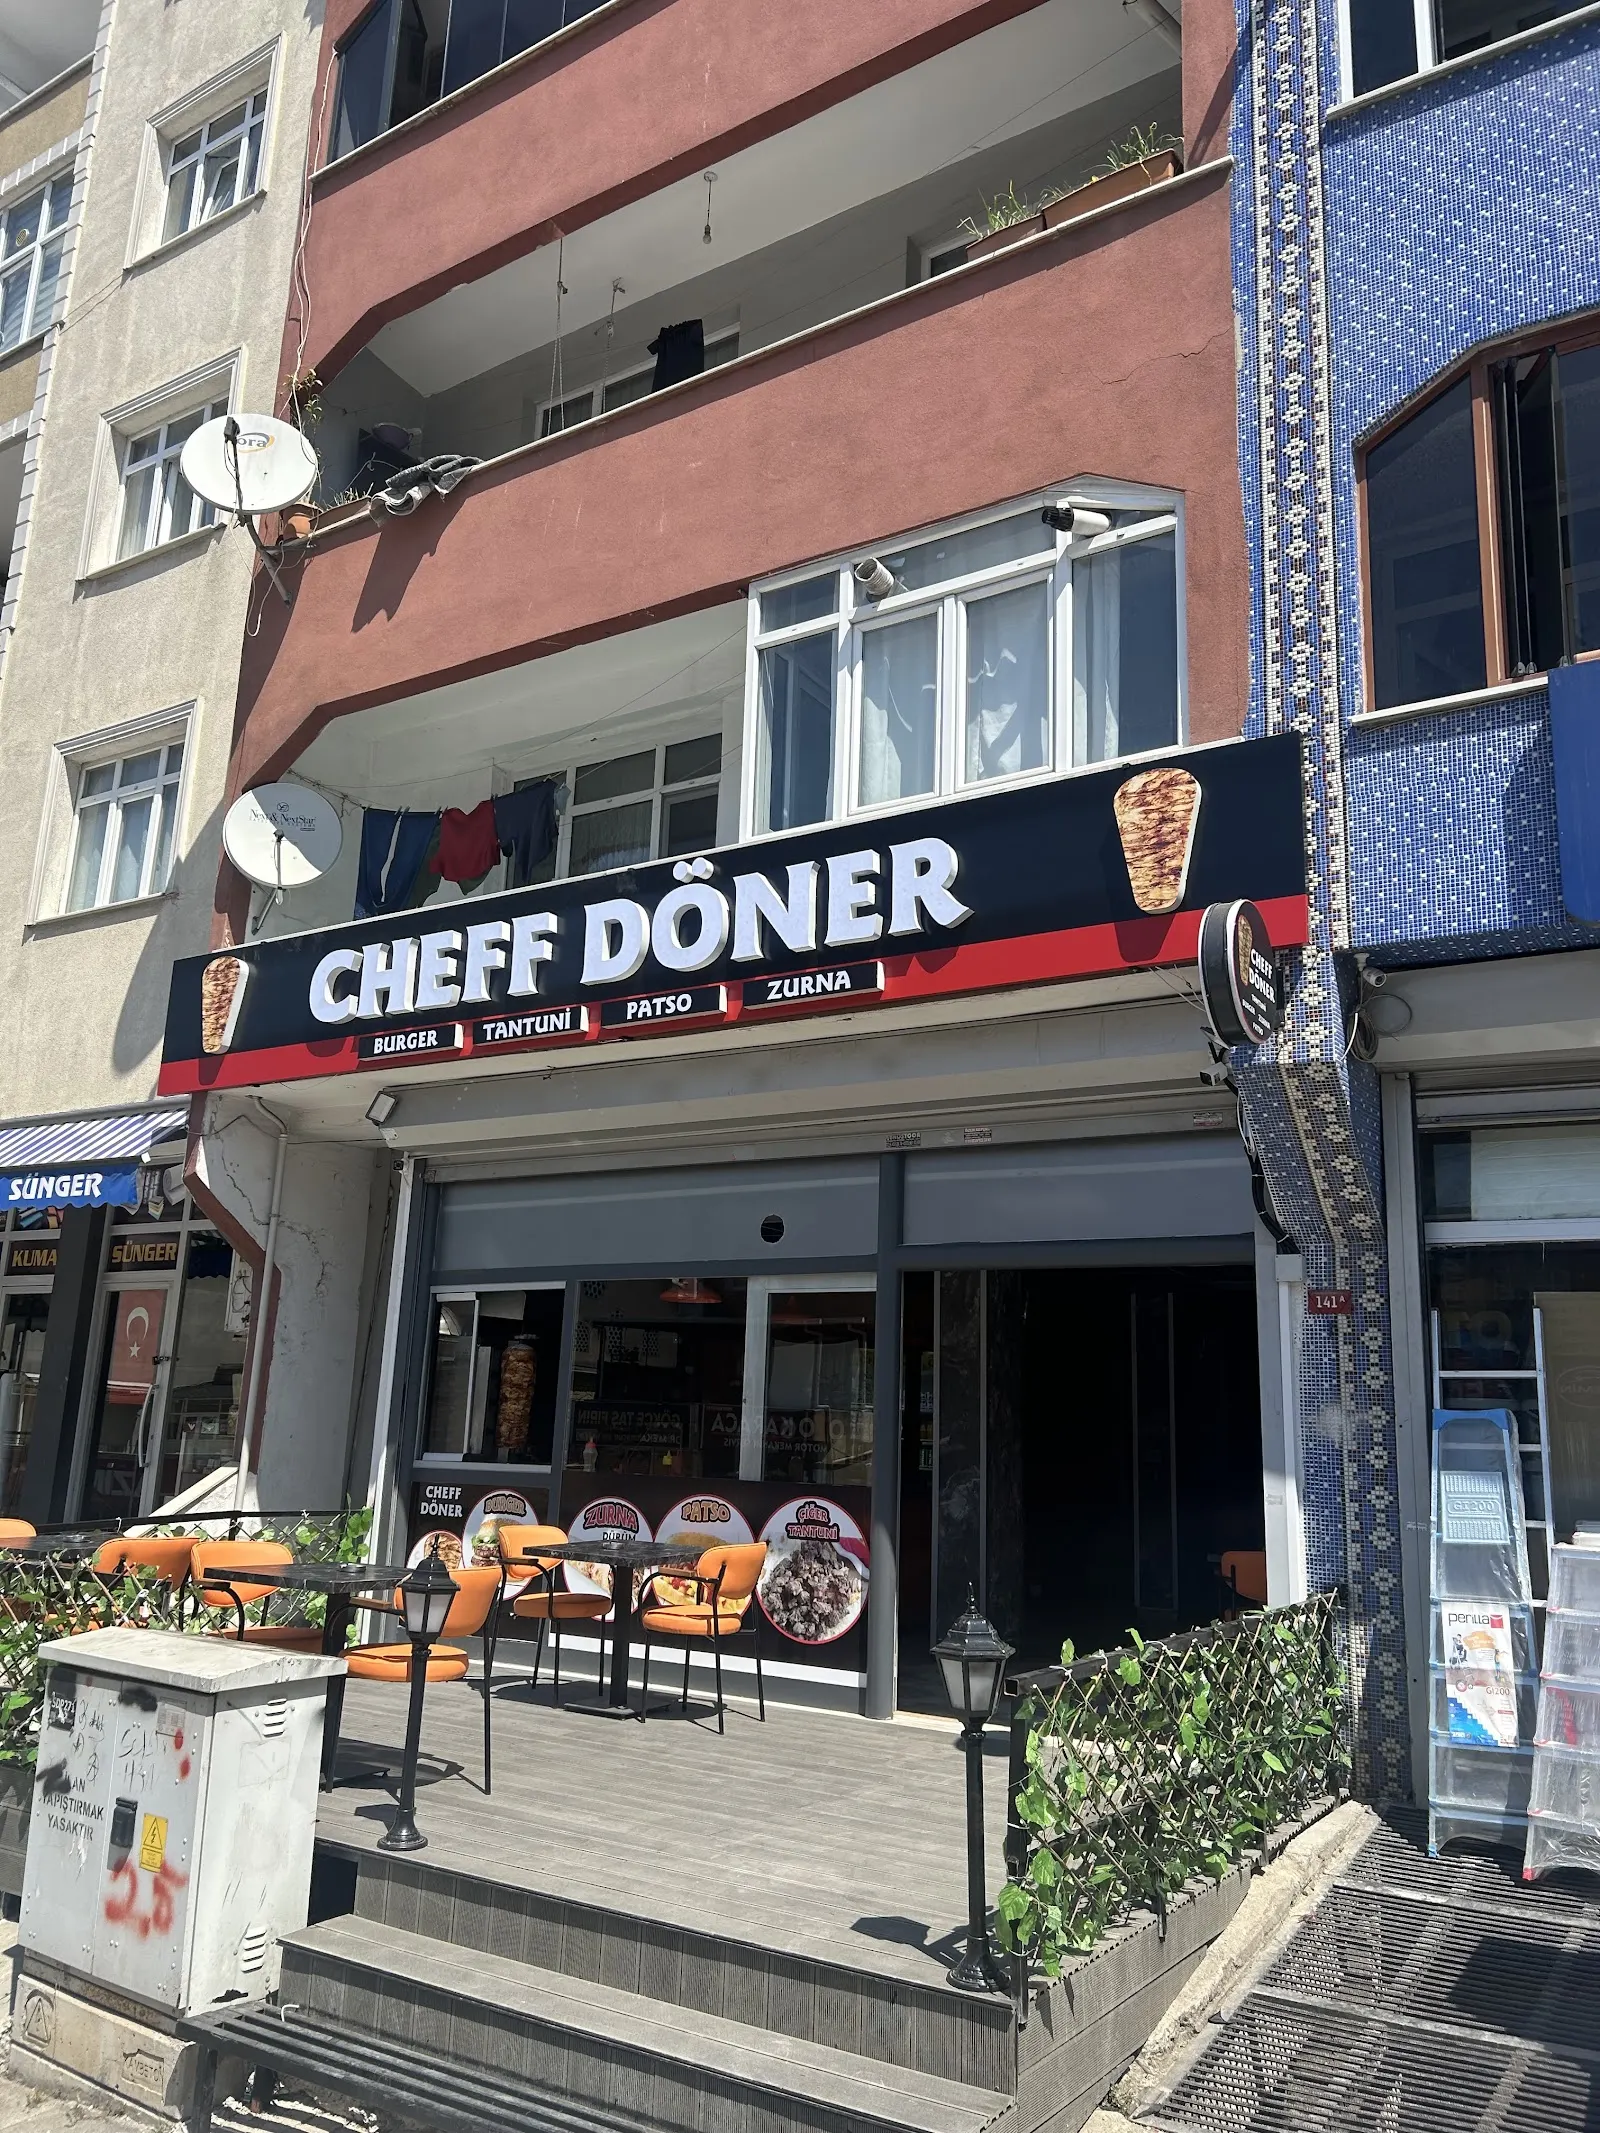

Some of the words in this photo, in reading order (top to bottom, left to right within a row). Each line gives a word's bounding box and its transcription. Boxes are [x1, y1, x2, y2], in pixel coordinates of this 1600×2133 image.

[237, 437, 267, 448] ora
[309, 912, 557, 1024] CHEFF
[581, 838, 974, 985] DÖNER
[1250, 948, 1273, 979] CHEFF
[766, 970, 852, 1001] ZURNA
[1248, 966, 1275, 1003] DÖNER
[626, 993, 693, 1020] PATSO
[482, 1007, 571, 1041] TANTUNİ
[373, 1029, 439, 1055] BURGER
[8, 1172, 103, 1201] SÜNGER
[12, 1249, 57, 1267] KUMA
[111, 1240, 178, 1264] SÜNGER
[425, 1485, 462, 1500] CHEFF
[484, 1494, 526, 1516] BURGER
[419, 1500, 463, 1518] DÖNER
[585, 1503, 639, 1531] ZURNA
[682, 1501, 730, 1522] PATSO
[602, 1529, 636, 1541] DÜRÜM
[788, 1525, 838, 1540] TANTUNİ
[1448, 1613, 1490, 1627] perilla
[47, 1813, 94, 1842] YASAKTIR
